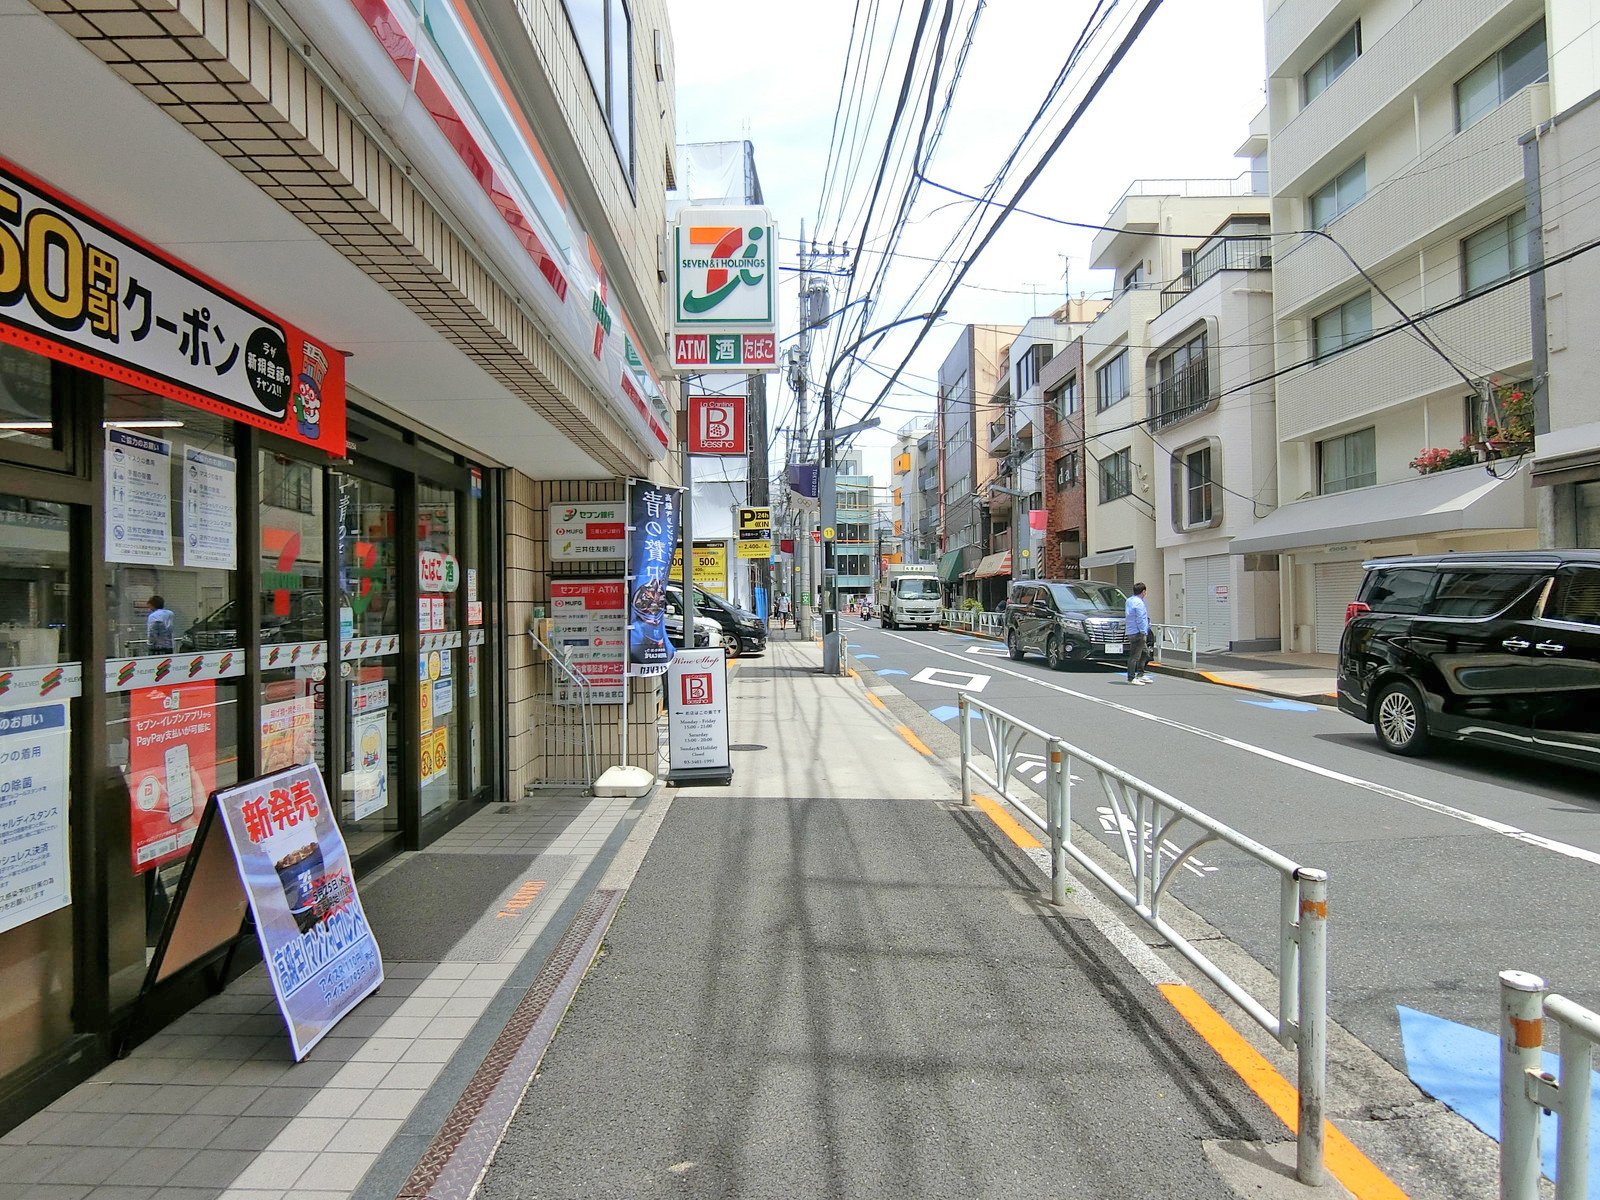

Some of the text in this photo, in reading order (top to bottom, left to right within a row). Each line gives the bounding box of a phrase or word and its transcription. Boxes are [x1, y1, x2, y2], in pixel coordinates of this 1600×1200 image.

[721, 258, 765, 268] HOLDINGS
[677, 339, 706, 360] ATM
[715, 339, 735, 361] 酒
[744, 338, 774, 359] たばこ
[706, 407, 730, 440] B
[700, 440, 734, 448] Bessho
[580, 511, 615, 519] セブン銀行
[740, 509, 756, 528] P
[421, 557, 442, 581] たばこ
[445, 560, 454, 582] 酒
[560, 585, 619, 594] セブン銀行 ATM
[672, 656, 719, 669] Wine Shop
[136, 722, 211, 747] PayPay支払いが可能に
[241, 780, 320, 844] 新発売
